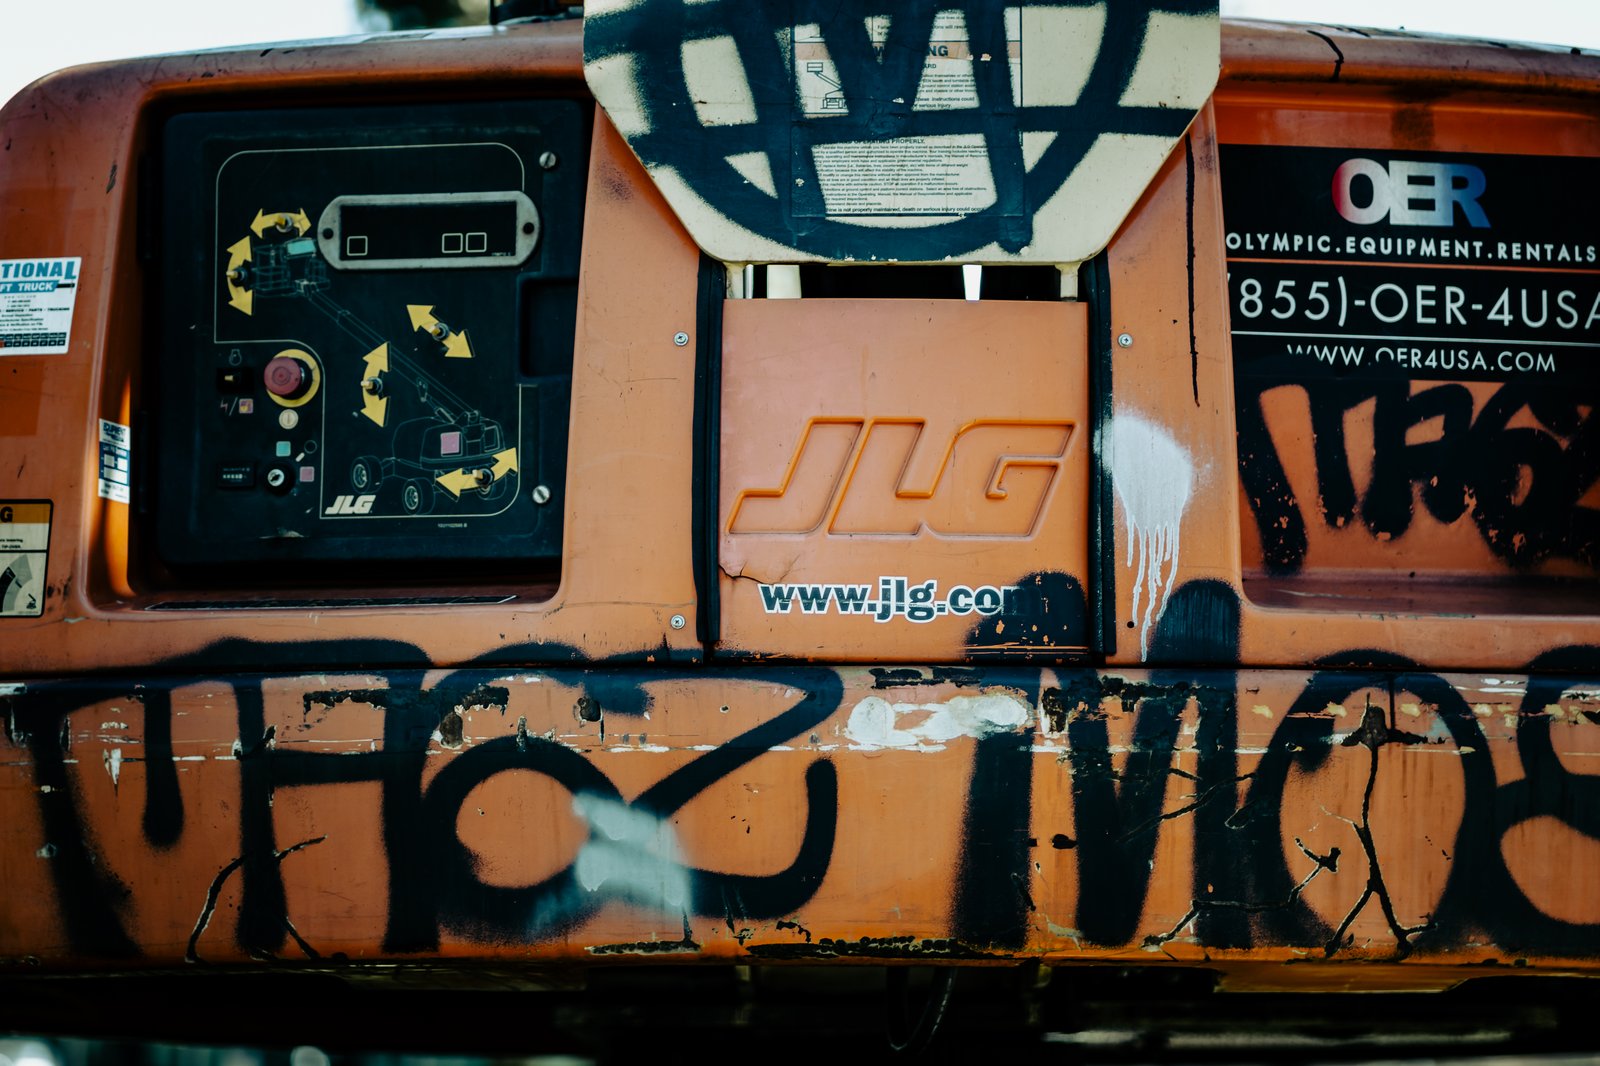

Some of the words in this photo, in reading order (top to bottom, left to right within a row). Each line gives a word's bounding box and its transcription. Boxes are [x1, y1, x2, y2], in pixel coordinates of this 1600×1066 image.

[1331, 158, 1491, 228] OER
[18, 282, 53, 291] TRUCK
[725, 415, 1078, 540] JLG
[325, 495, 376, 514] JLG
